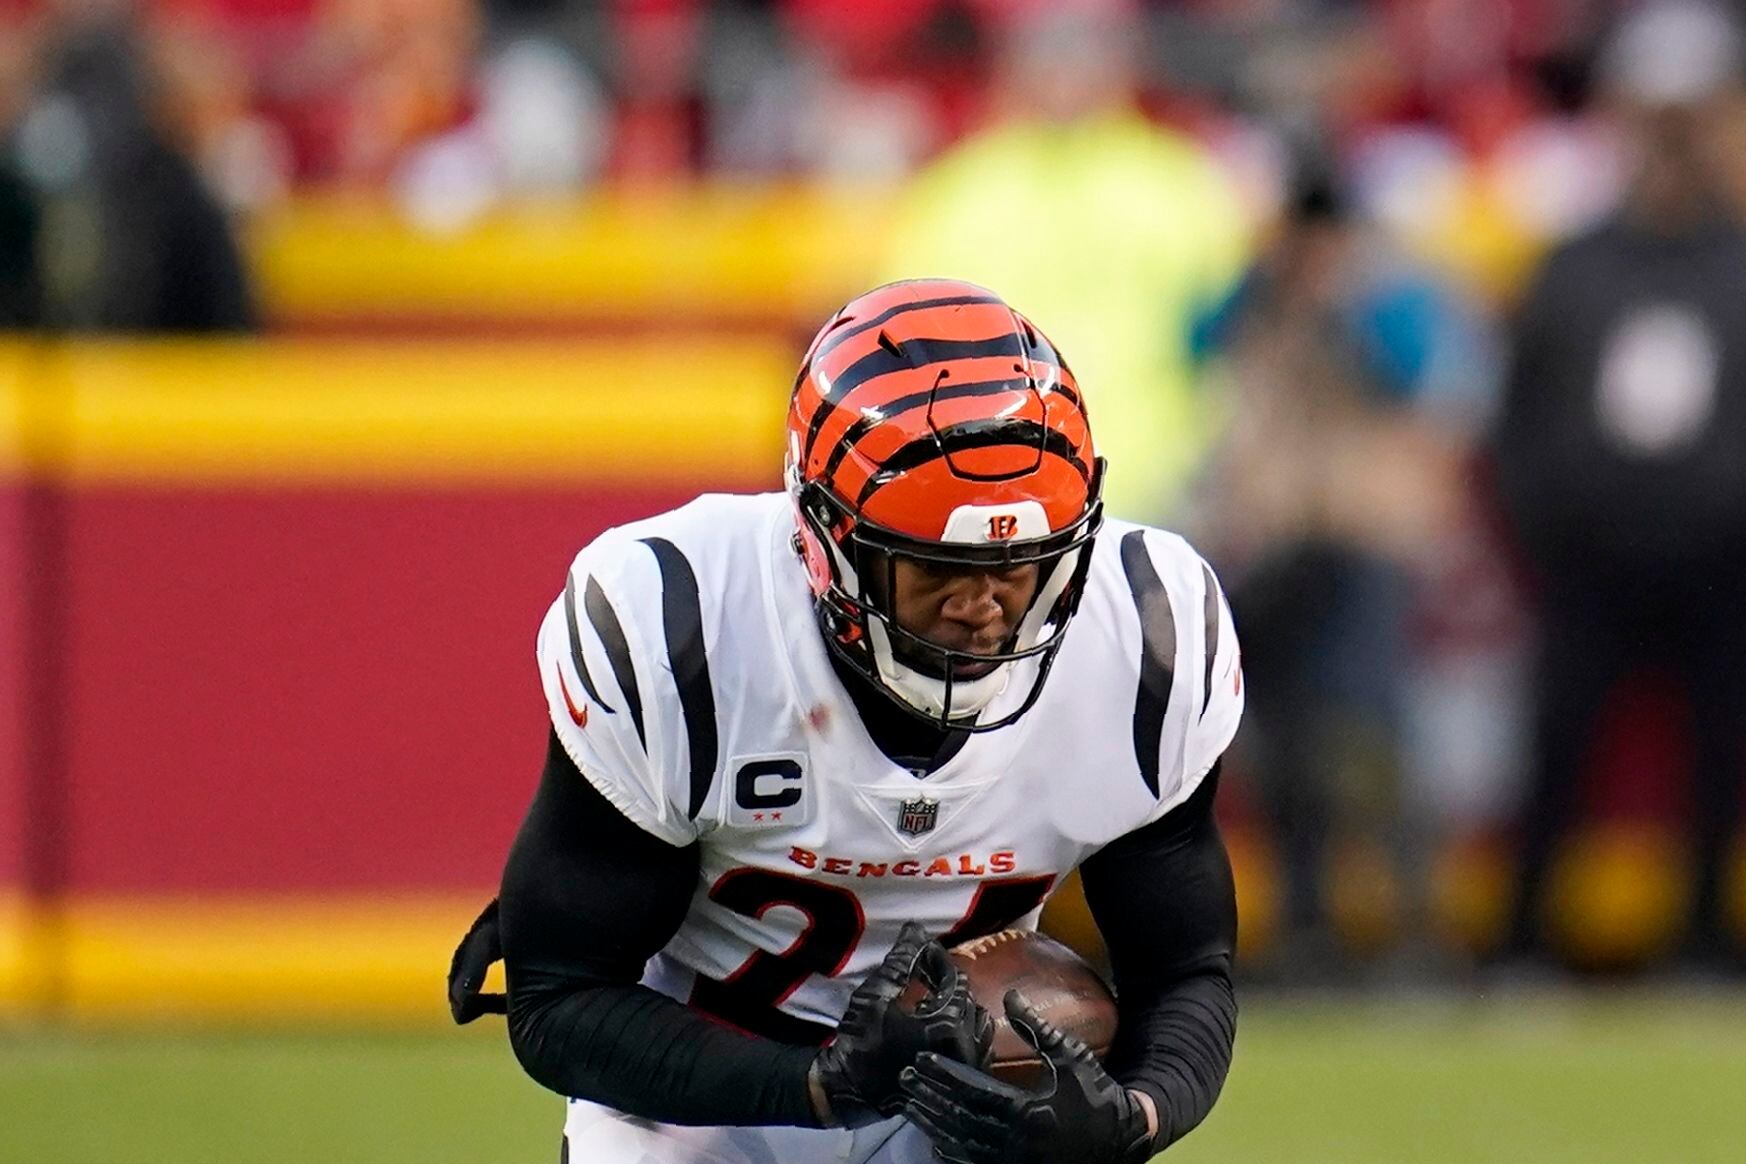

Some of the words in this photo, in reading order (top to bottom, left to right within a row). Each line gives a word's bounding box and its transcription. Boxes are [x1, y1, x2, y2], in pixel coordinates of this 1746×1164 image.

[735, 759, 803, 810] C
[788, 845, 1017, 879] BENGALS
[688, 867, 1057, 1048] 2
